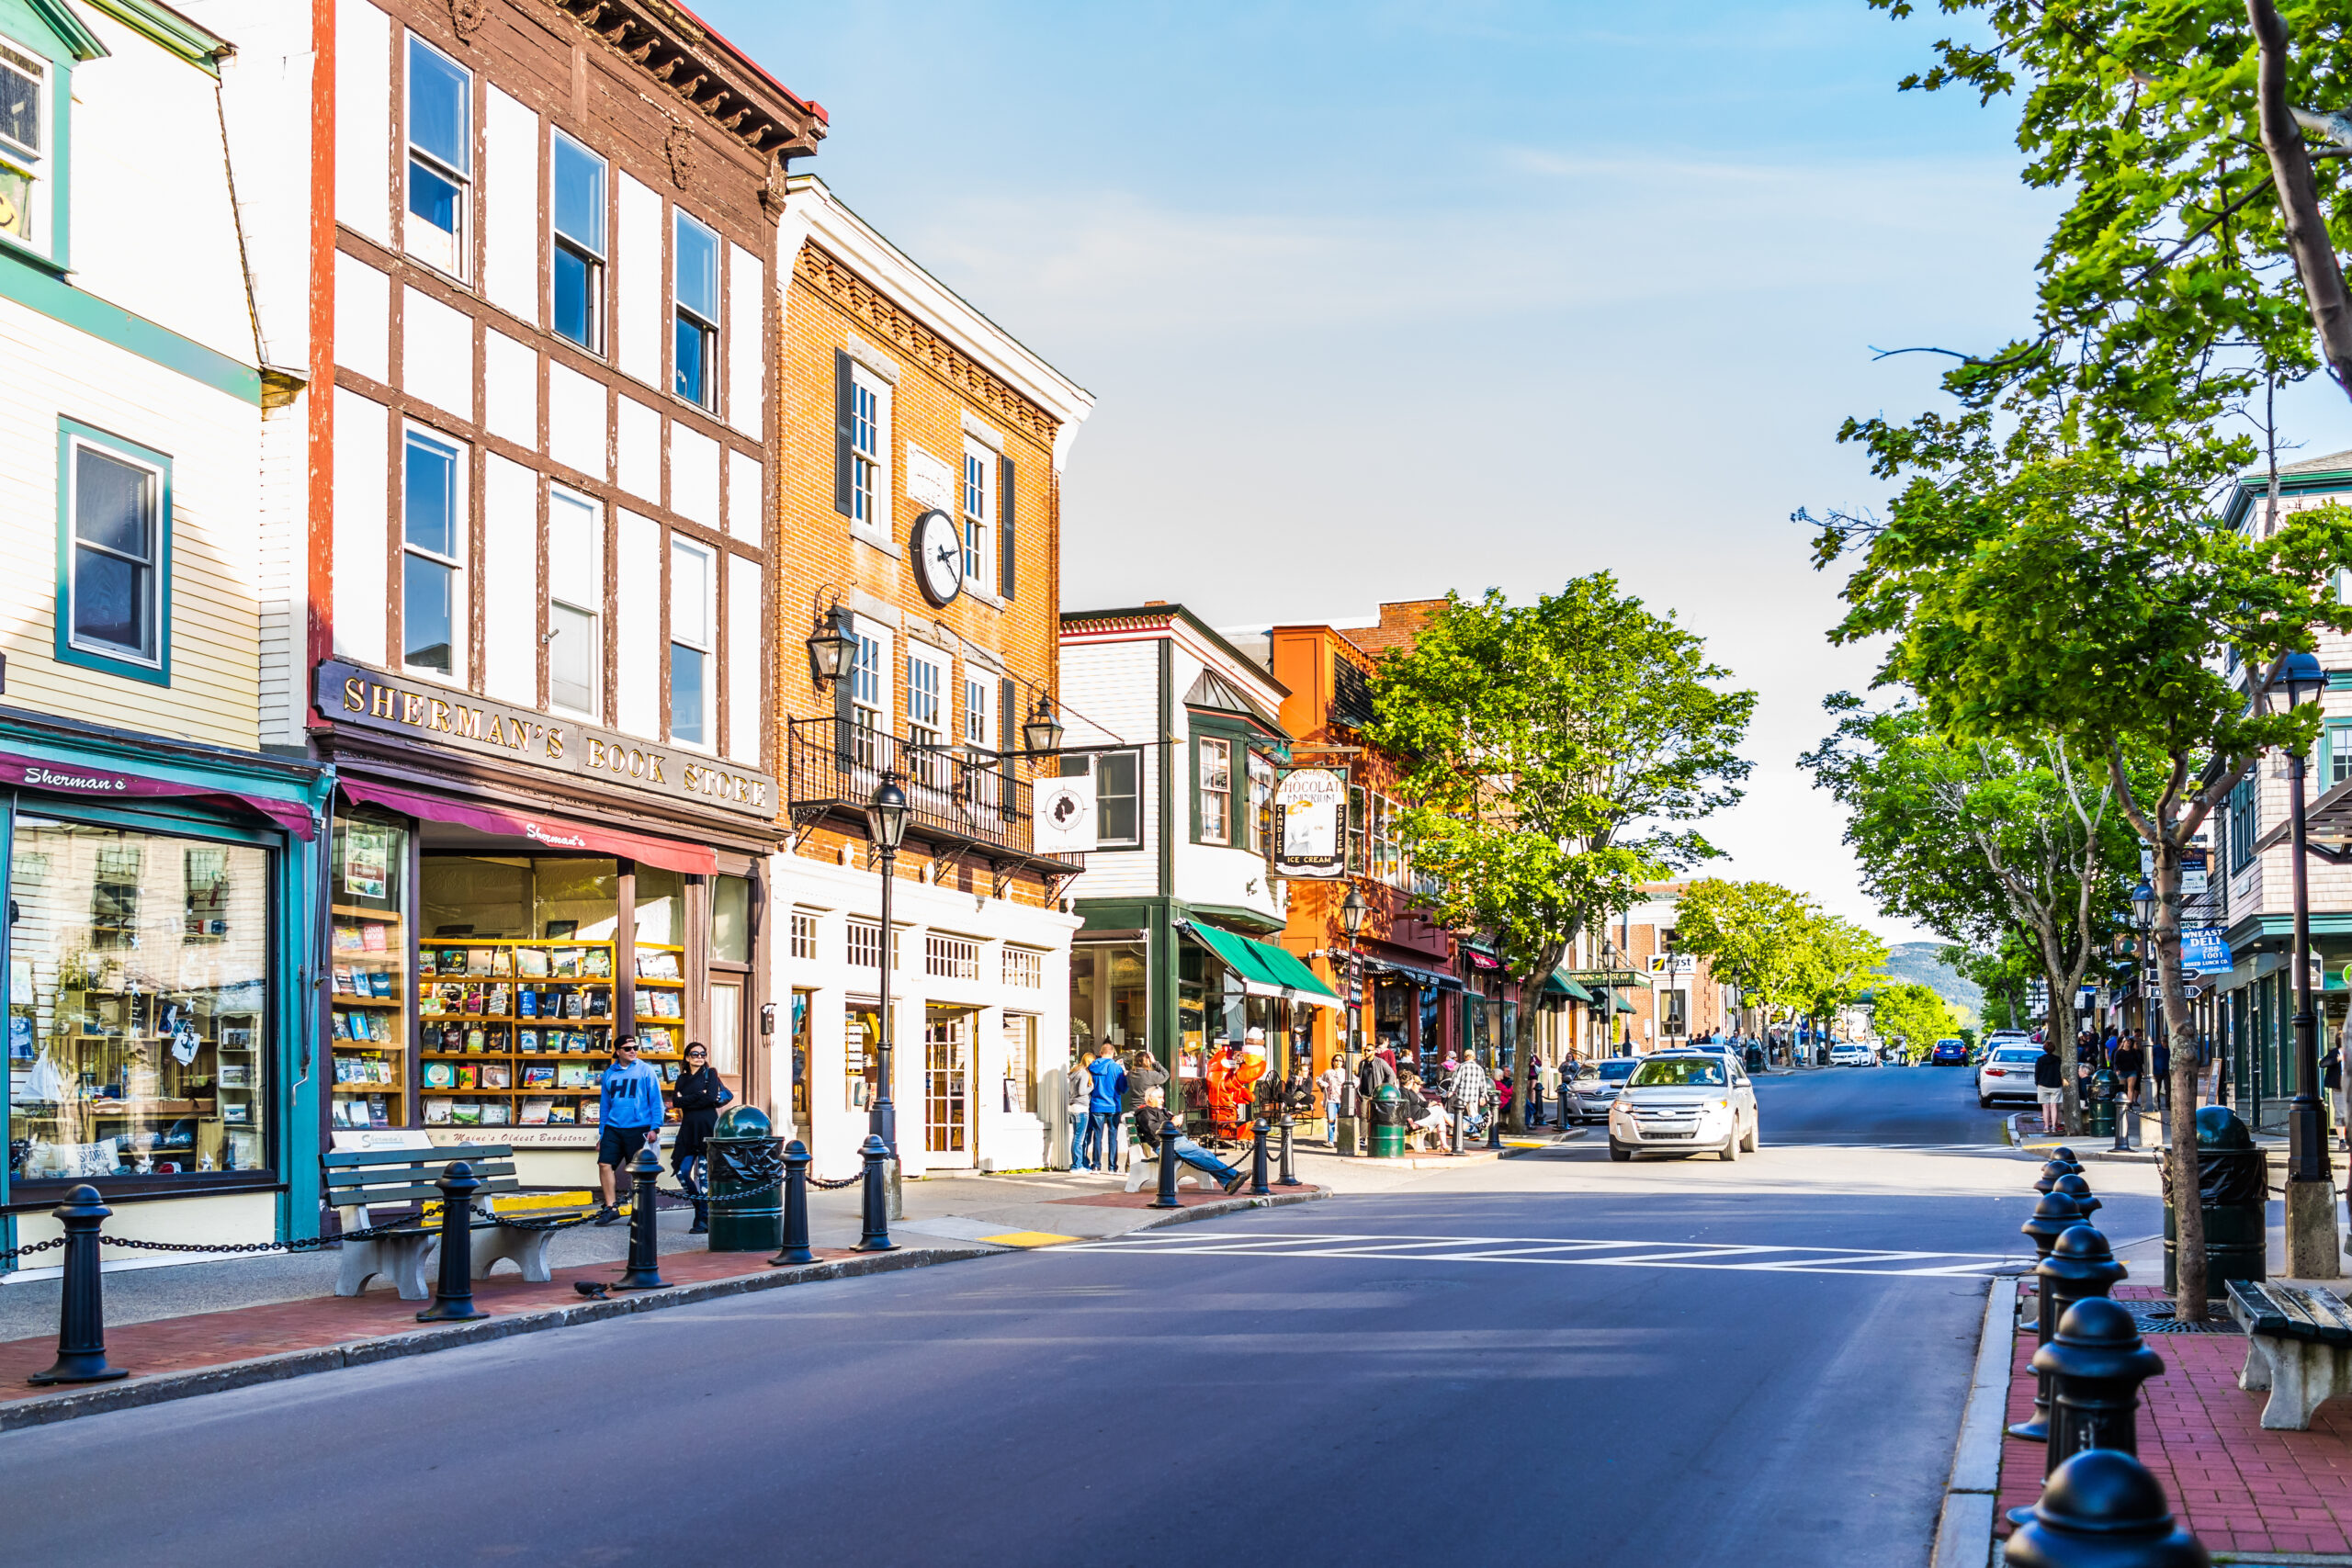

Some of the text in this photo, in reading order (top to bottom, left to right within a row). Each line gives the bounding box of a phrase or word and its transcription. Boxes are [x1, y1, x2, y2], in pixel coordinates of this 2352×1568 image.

[344, 676, 766, 808] SHERMAN'S BOOK STORE
[24, 767, 127, 790] Shermans
[1277, 780, 1346, 794] CHOCOLATE
[1287, 794, 1335, 804] EMPORIUM
[526, 823, 586, 847] Sherman's
[365, 932, 384, 941] MOON
[2181, 929, 2223, 939] WNEAST
[2190, 936, 2221, 947] DELI
[2202, 952, 2223, 960] 1001
[609, 1077, 639, 1100] HI
[453, 1133, 588, 1143] Maine's Oldest Bookstore
[78, 1148, 109, 1164] SHORE
